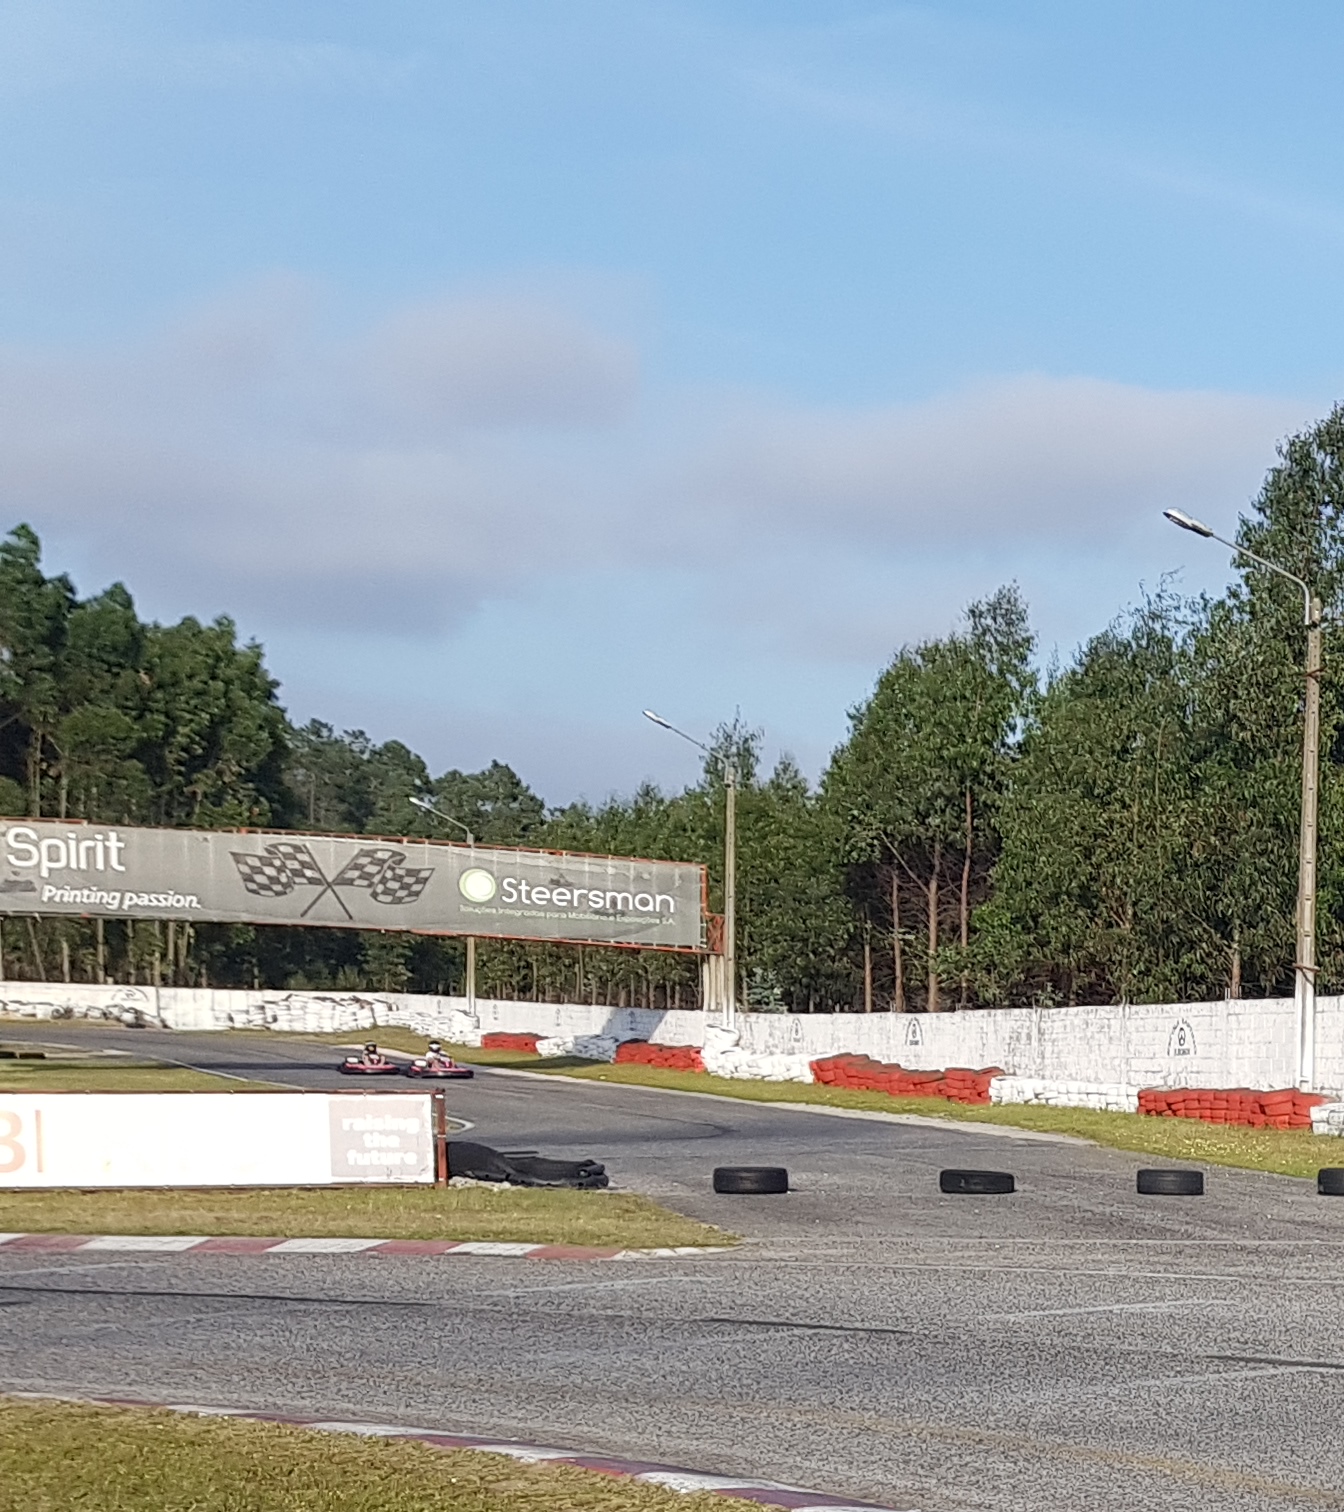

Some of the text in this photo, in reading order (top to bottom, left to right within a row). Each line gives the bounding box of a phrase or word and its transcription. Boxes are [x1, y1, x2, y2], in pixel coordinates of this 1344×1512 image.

[6, 826, 126, 878] Spirit
[41, 884, 121, 910] Printing
[501, 877, 675, 913] Steersman
[363, 1131, 400, 1148] the
[346, 1149, 418, 1166] future
